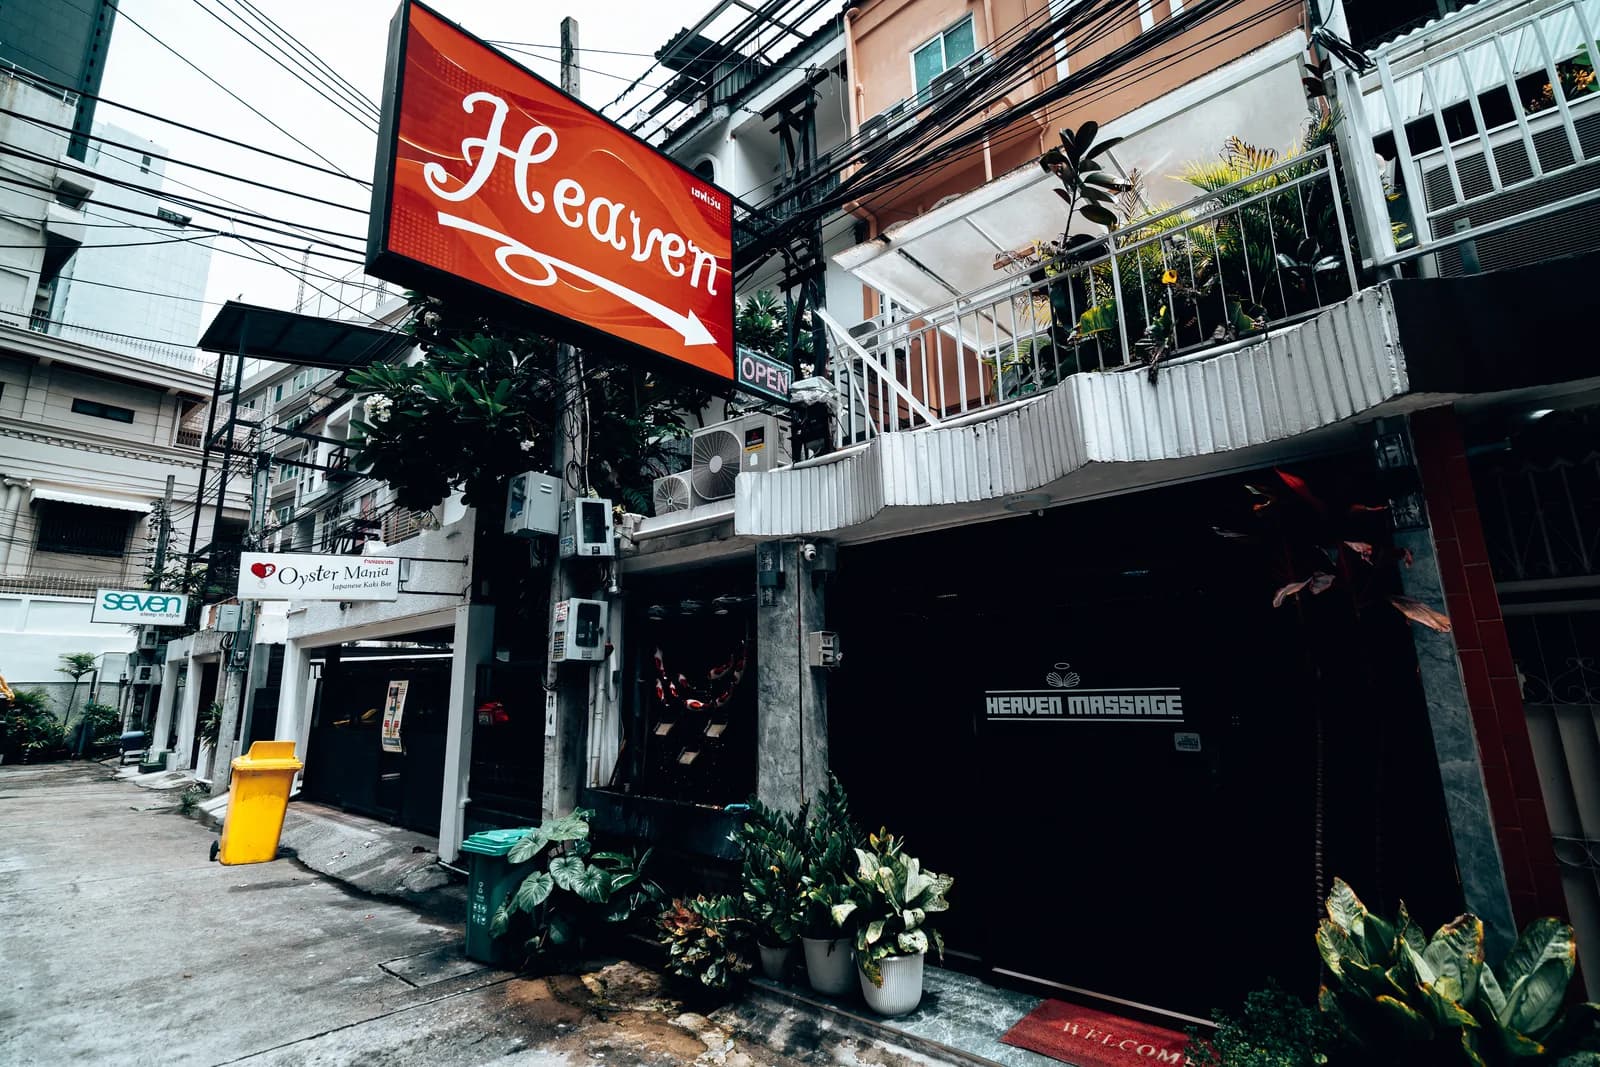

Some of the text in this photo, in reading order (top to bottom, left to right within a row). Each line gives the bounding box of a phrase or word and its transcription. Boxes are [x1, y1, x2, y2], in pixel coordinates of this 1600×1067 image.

[424, 92, 717, 295] Heaven
[742, 357, 788, 395] OPEN
[278, 565, 389, 590] Oyster Mania
[102, 593, 181, 613] seven
[985, 696, 1183, 715] HEAVEN MASSAGE
